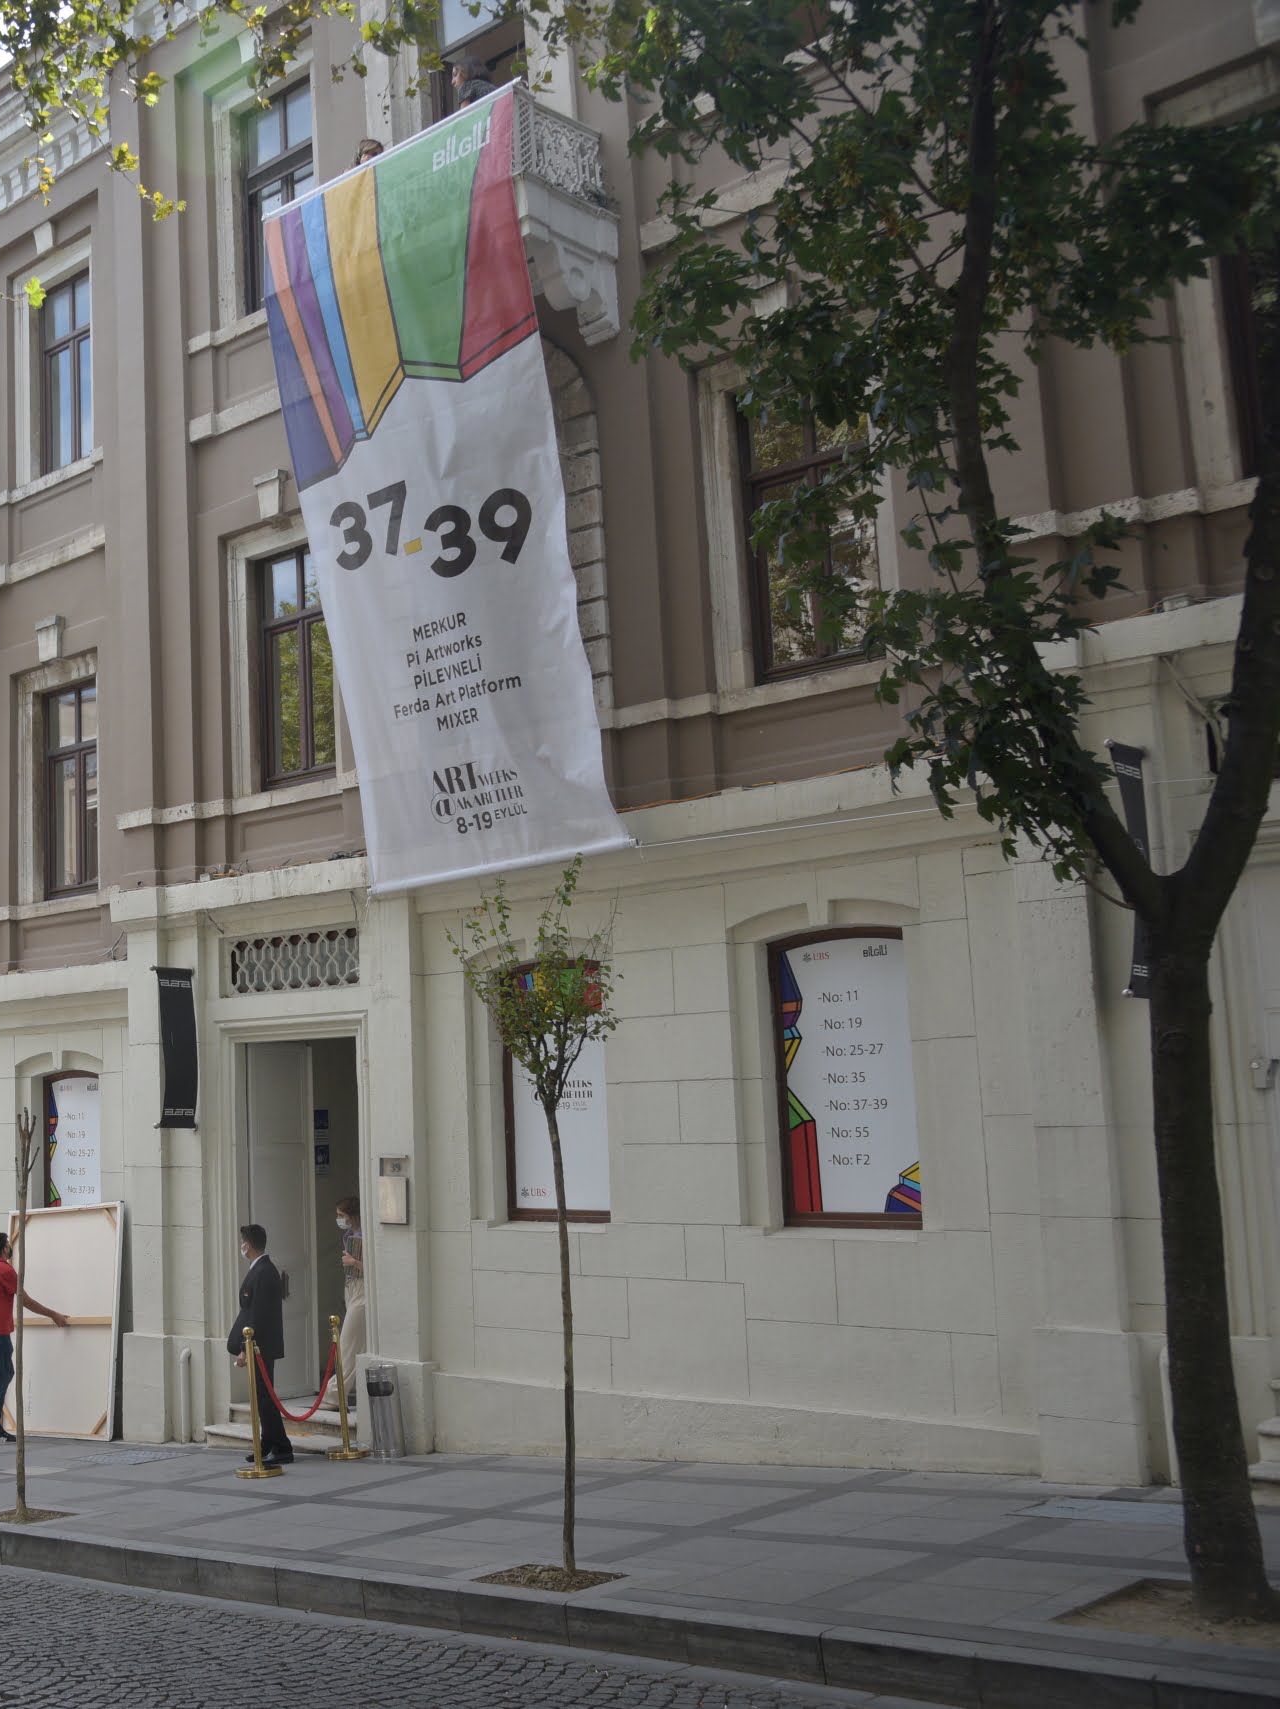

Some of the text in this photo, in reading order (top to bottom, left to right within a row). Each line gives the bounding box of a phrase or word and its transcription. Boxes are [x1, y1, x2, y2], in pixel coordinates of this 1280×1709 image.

[329, 480, 532, 578] 37-39
[413, 612, 467, 642] MERKUR
[406, 635, 483, 668] Pi Artworks
[414, 653, 482, 690] PİLEVNELİ
[394, 675, 522, 719] Ferda Art Platform
[437, 708, 479, 731] MIXER
[456, 803, 528, 834] 8-19 EYLÜL
[846, 990, 858, 1001] 11
[848, 1017, 862, 1028] 19
[849, 1043, 883, 1056] 25-27
[851, 1071, 866, 1083] 35
[853, 1098, 888, 1110] 37-39
[855, 1127, 869, 1138] 55
[856, 1154, 870, 1165] F2
